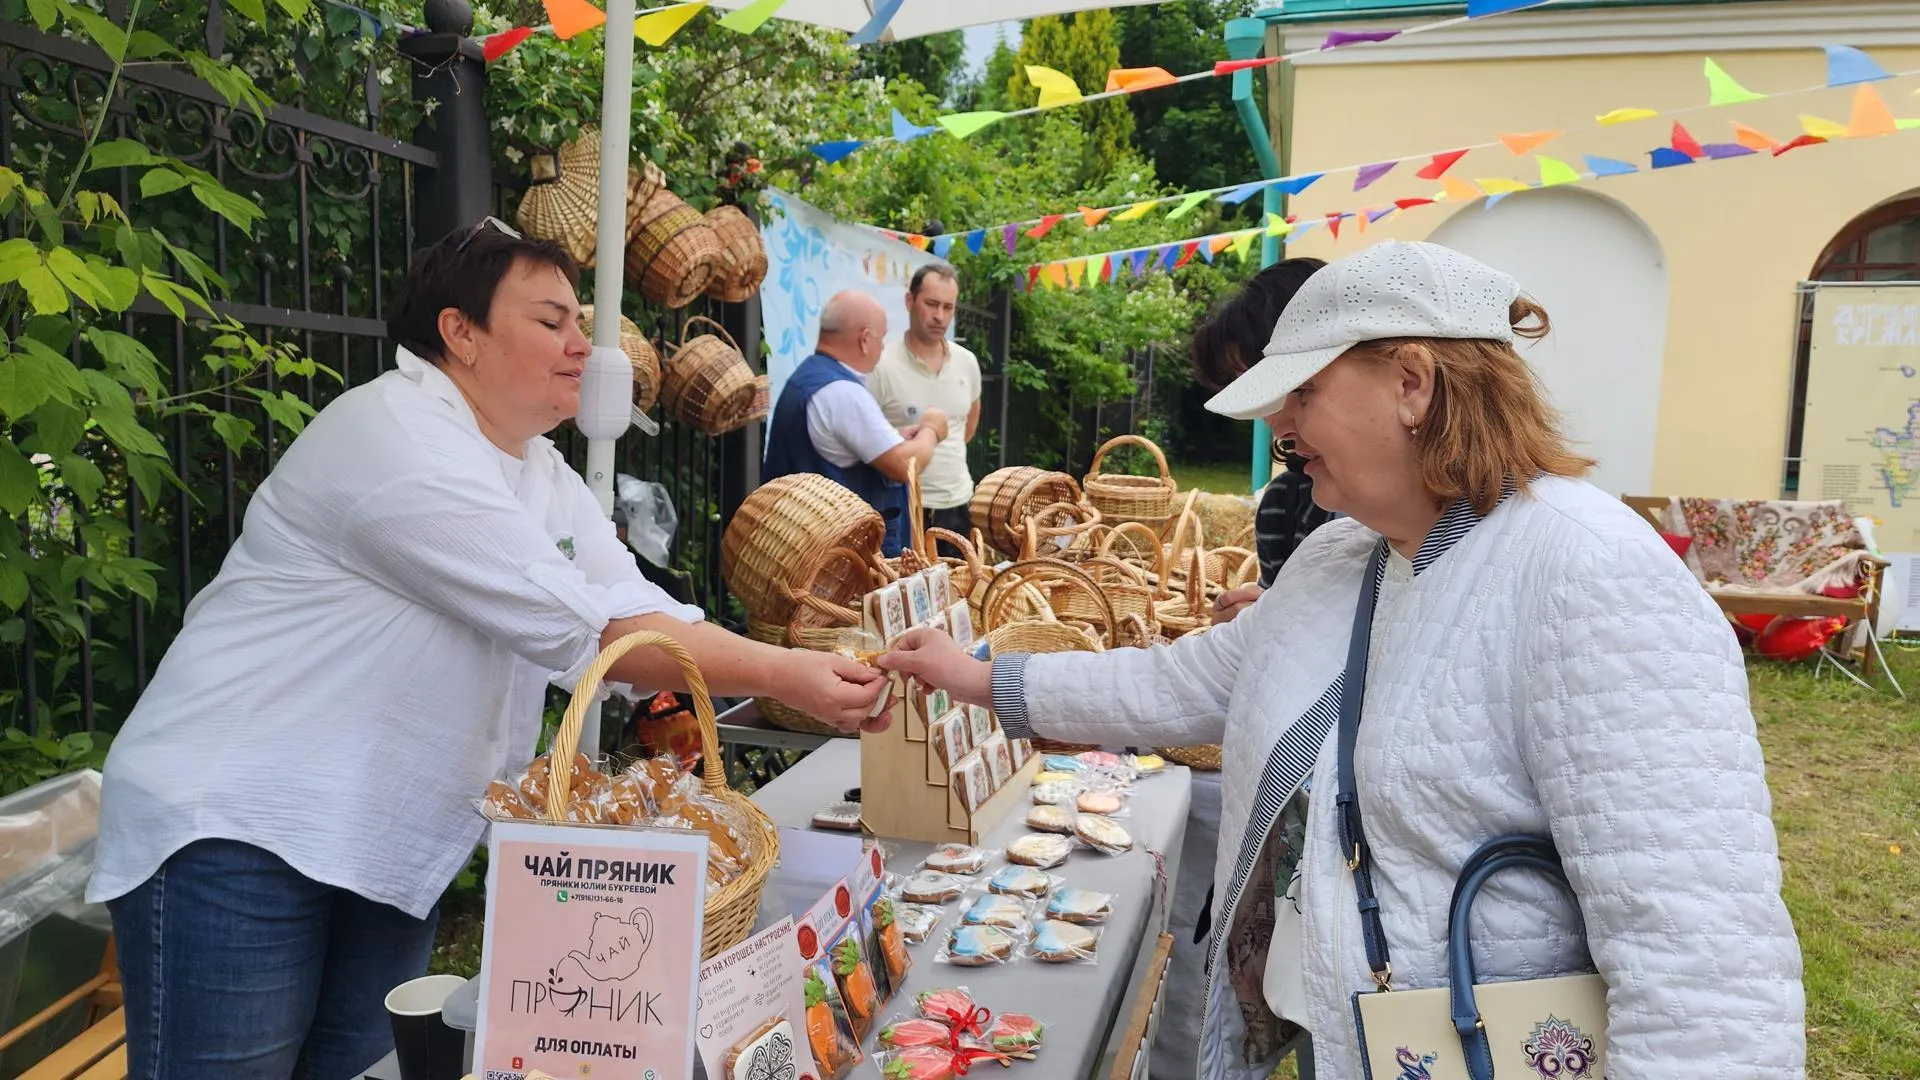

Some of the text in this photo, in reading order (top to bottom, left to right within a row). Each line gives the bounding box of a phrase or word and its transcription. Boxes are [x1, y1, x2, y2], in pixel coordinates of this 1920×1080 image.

[525, 851, 676, 885] ЧАЙ ПРЯНИК
[541, 879, 657, 894] ПРЯНИКИ ЮЛИИ БУКРЕЕВОЙ
[596, 935, 631, 964] ЧАЙ
[699, 921, 792, 982] ЛЕТ НА ХОРОШЕЕ НАСТРОЕНИЕ
[534, 1036, 637, 1060] ДЛЯ ОПЛАТЫ
